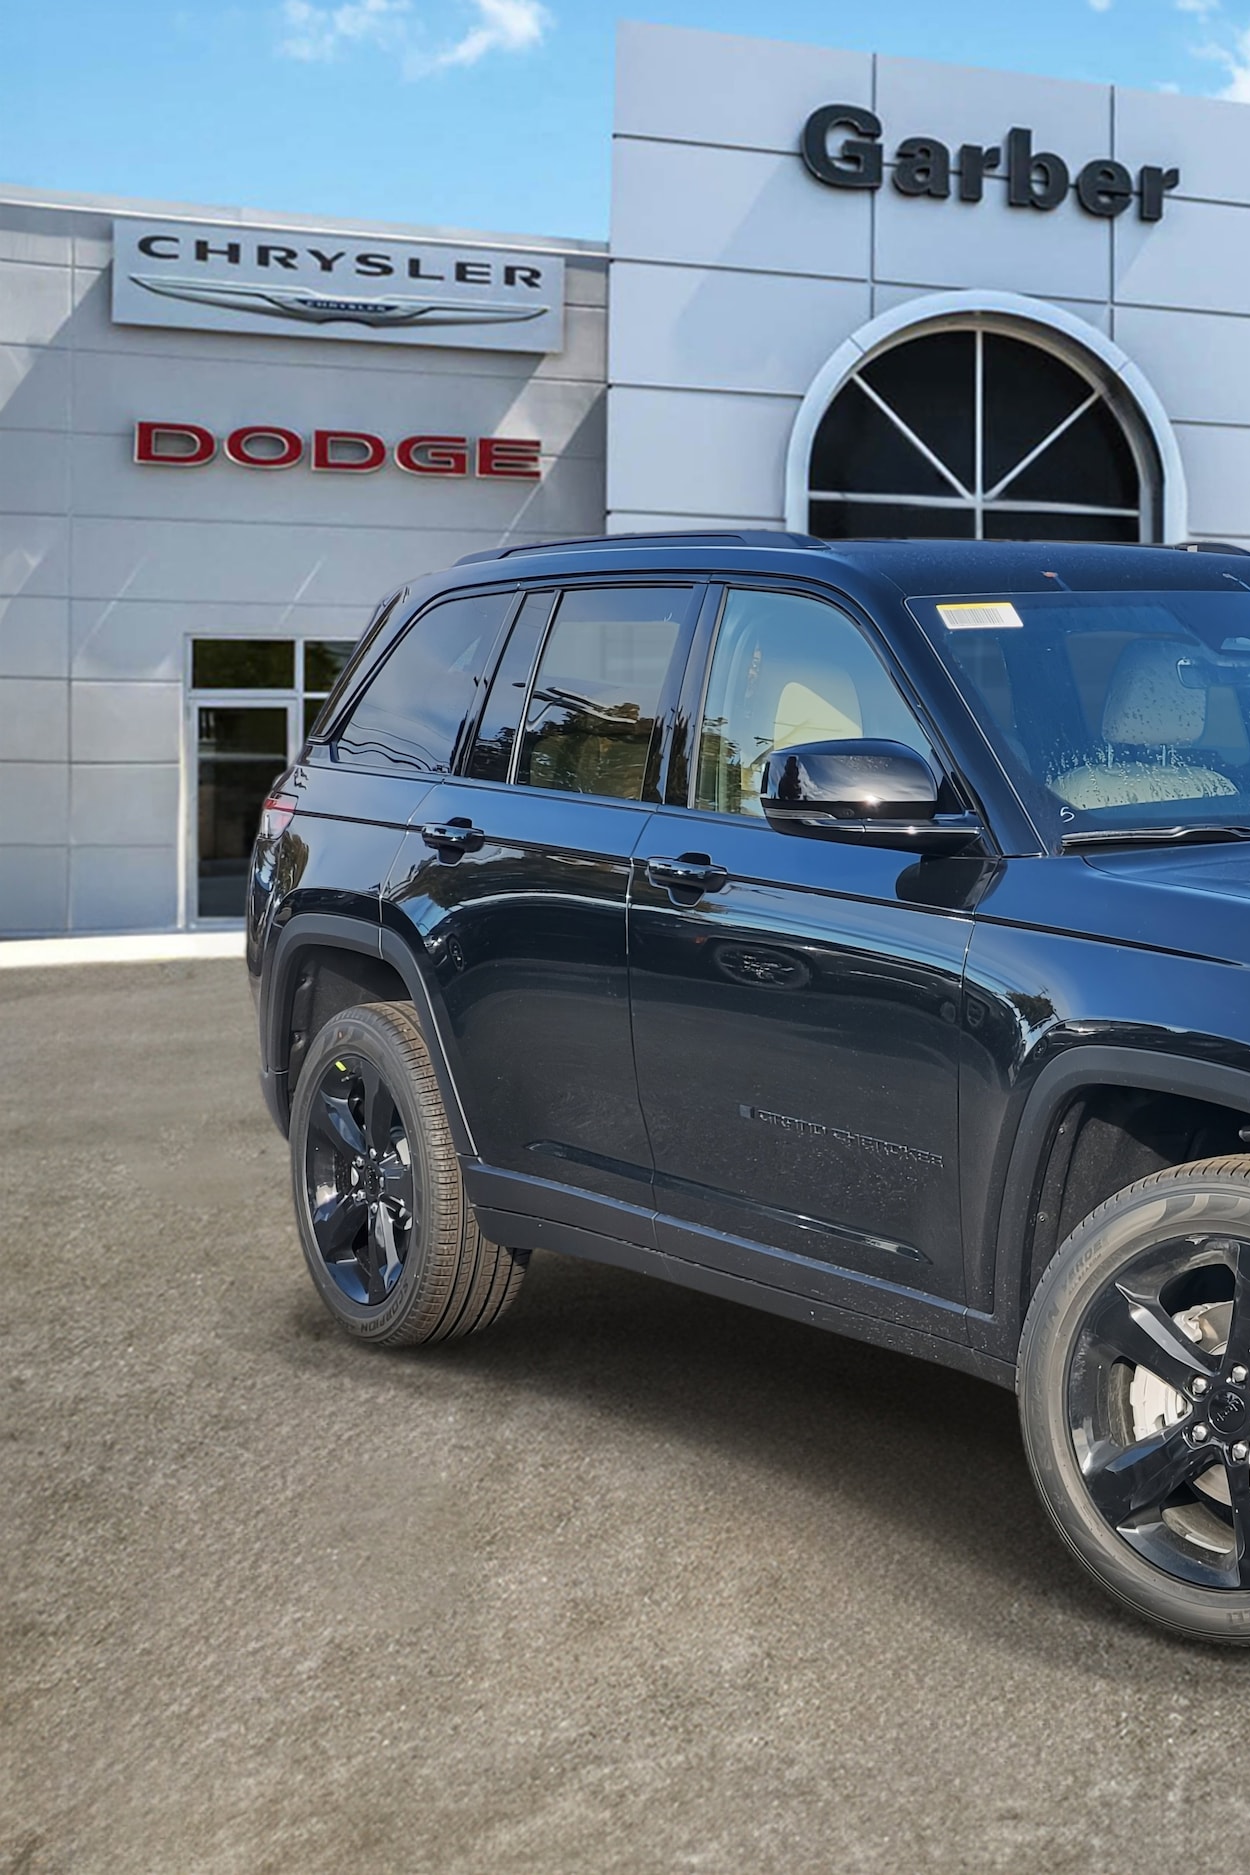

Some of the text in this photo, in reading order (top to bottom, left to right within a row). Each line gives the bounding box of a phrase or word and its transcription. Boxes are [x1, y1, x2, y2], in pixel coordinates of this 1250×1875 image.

[800, 104, 1180, 222] Garber
[137, 235, 542, 289] CHRYSLER
[134, 421, 542, 479] DODGE
